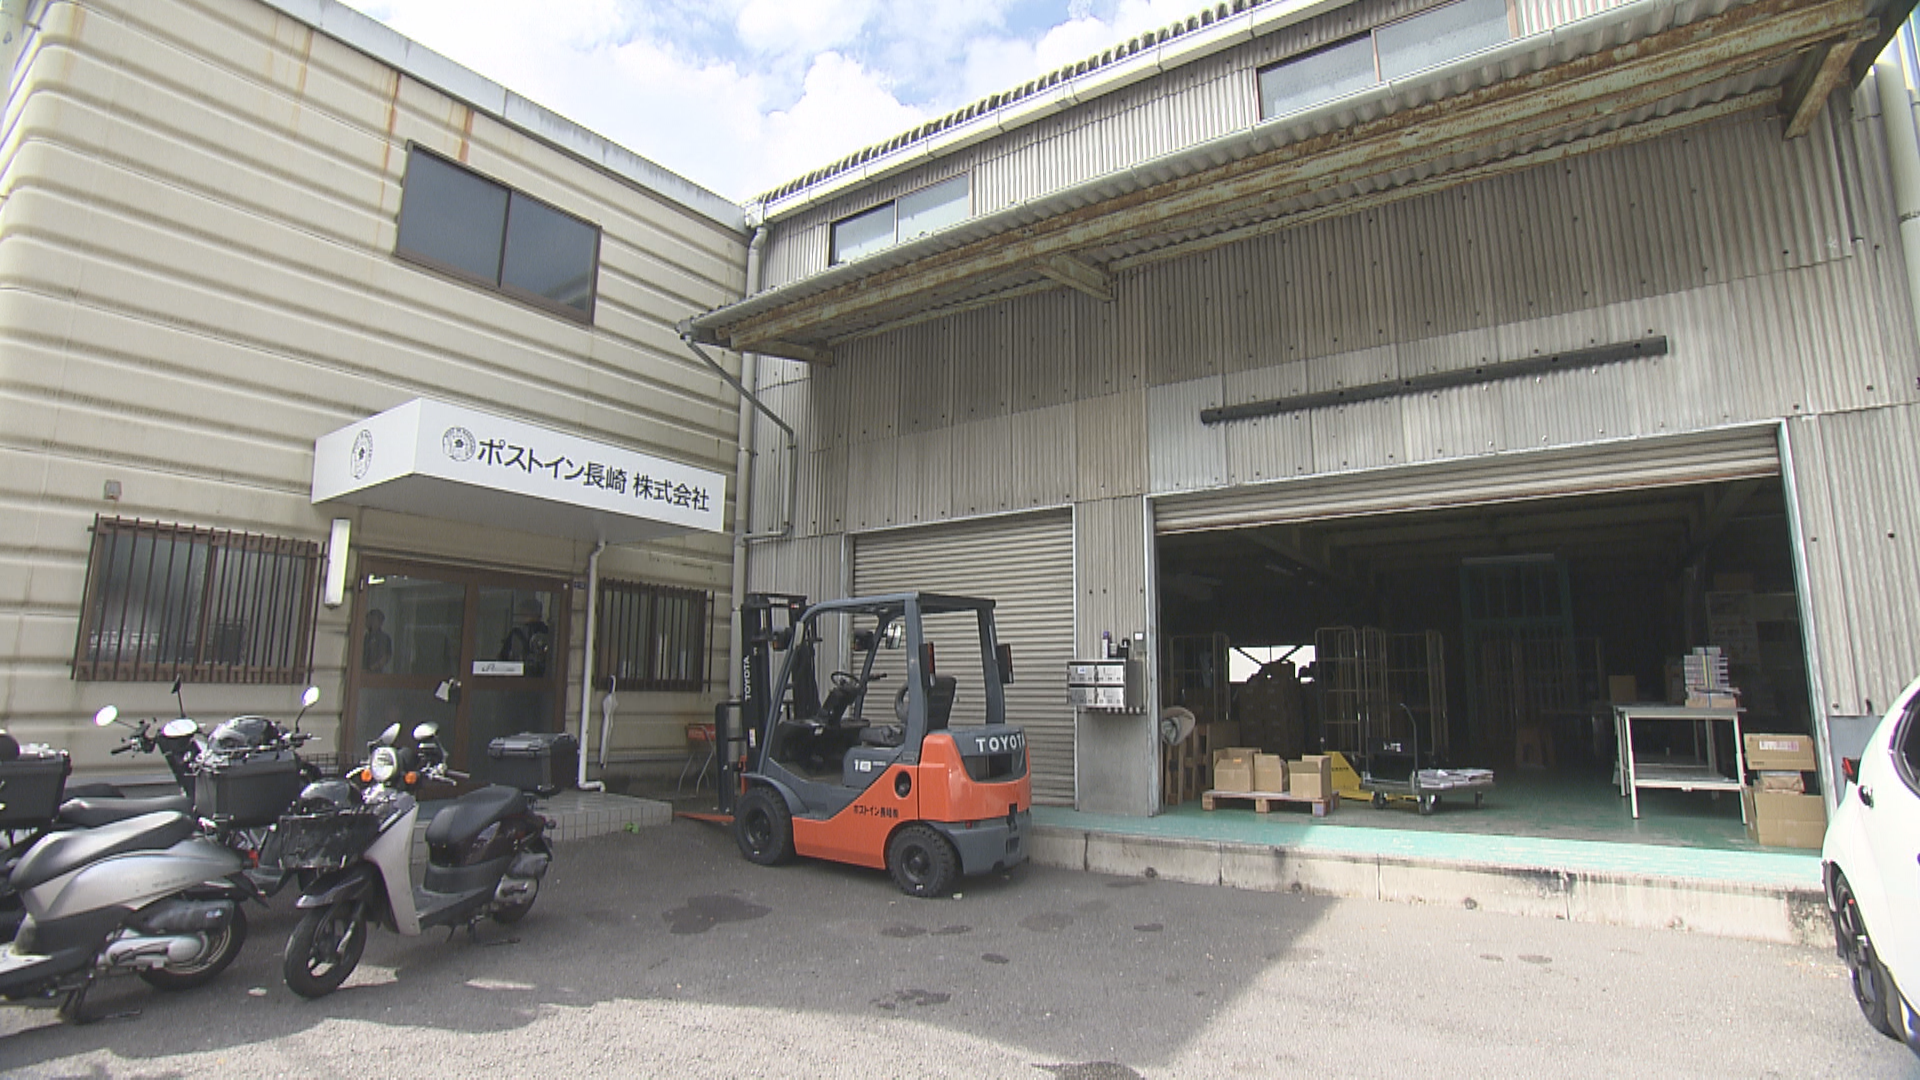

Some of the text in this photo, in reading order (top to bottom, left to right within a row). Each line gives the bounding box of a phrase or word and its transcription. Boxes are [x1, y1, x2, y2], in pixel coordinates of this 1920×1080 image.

[477, 439, 628, 494] ポストイン長崎
[632, 472, 710, 512] 株式会社
